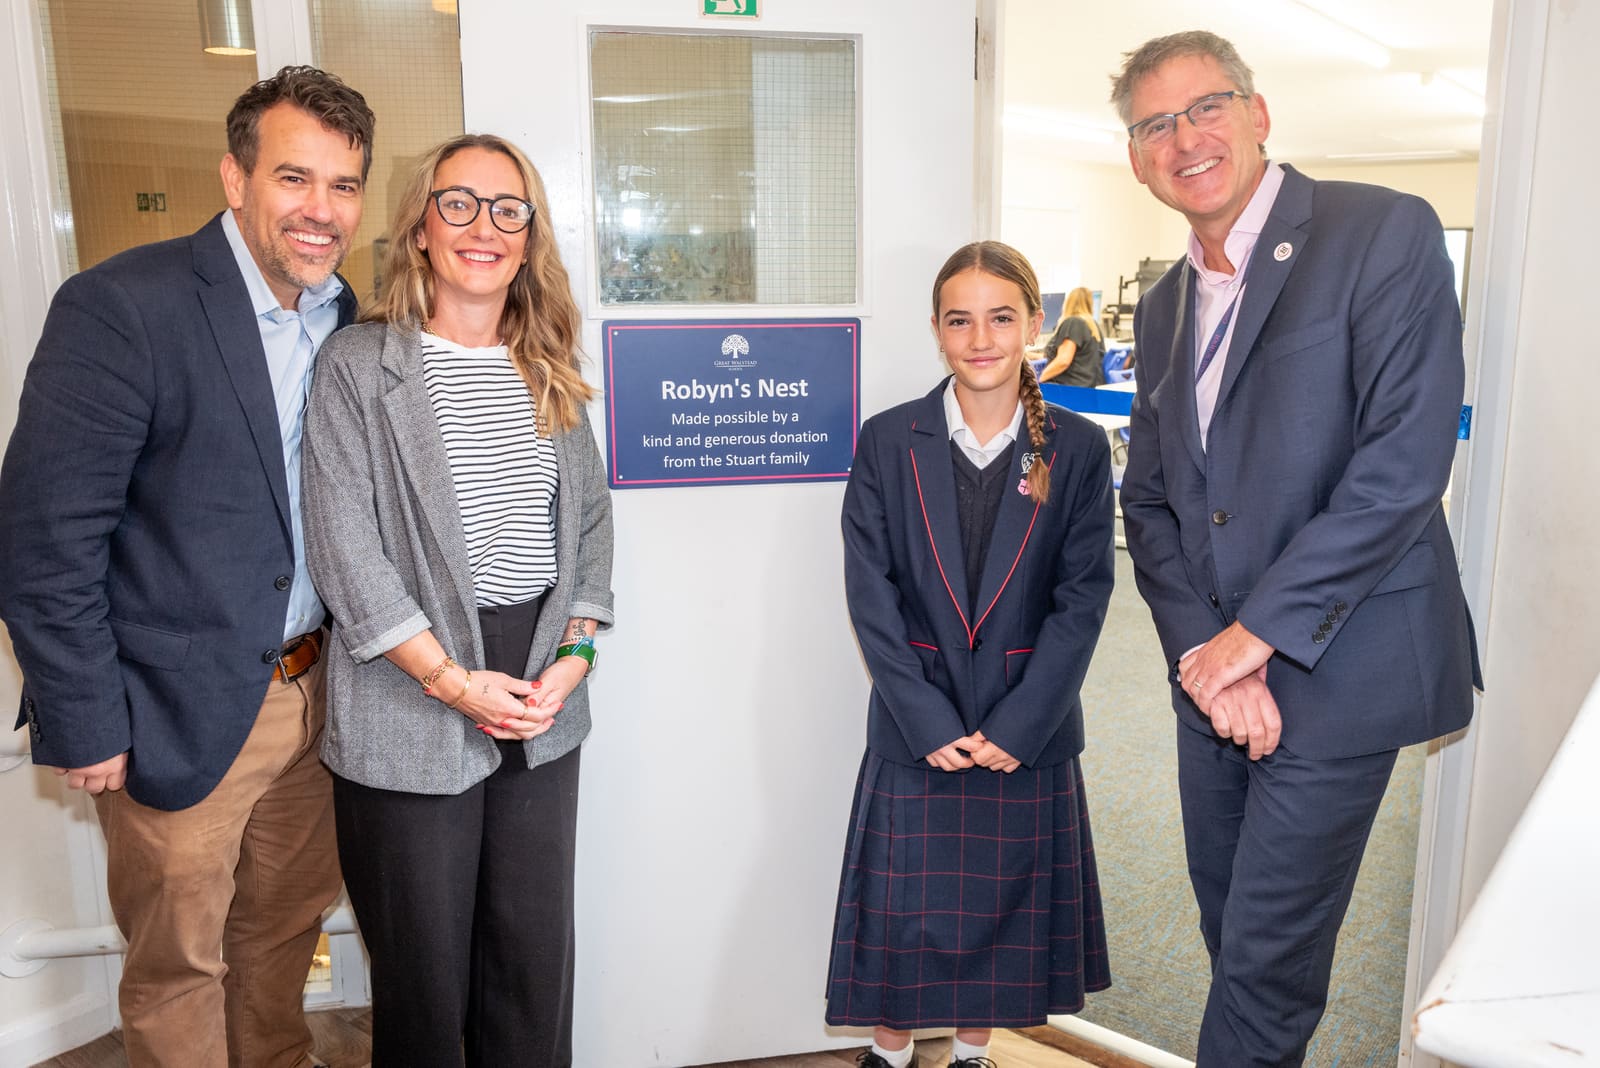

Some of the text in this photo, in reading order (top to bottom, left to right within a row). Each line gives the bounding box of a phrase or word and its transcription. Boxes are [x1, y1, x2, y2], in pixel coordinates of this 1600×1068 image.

[662, 378, 808, 404] Robyn's Nest
[672, 410, 799, 427] Made possible by a
[643, 431, 829, 448] kind and generous donation
[664, 451, 809, 468] from the Stuart family
